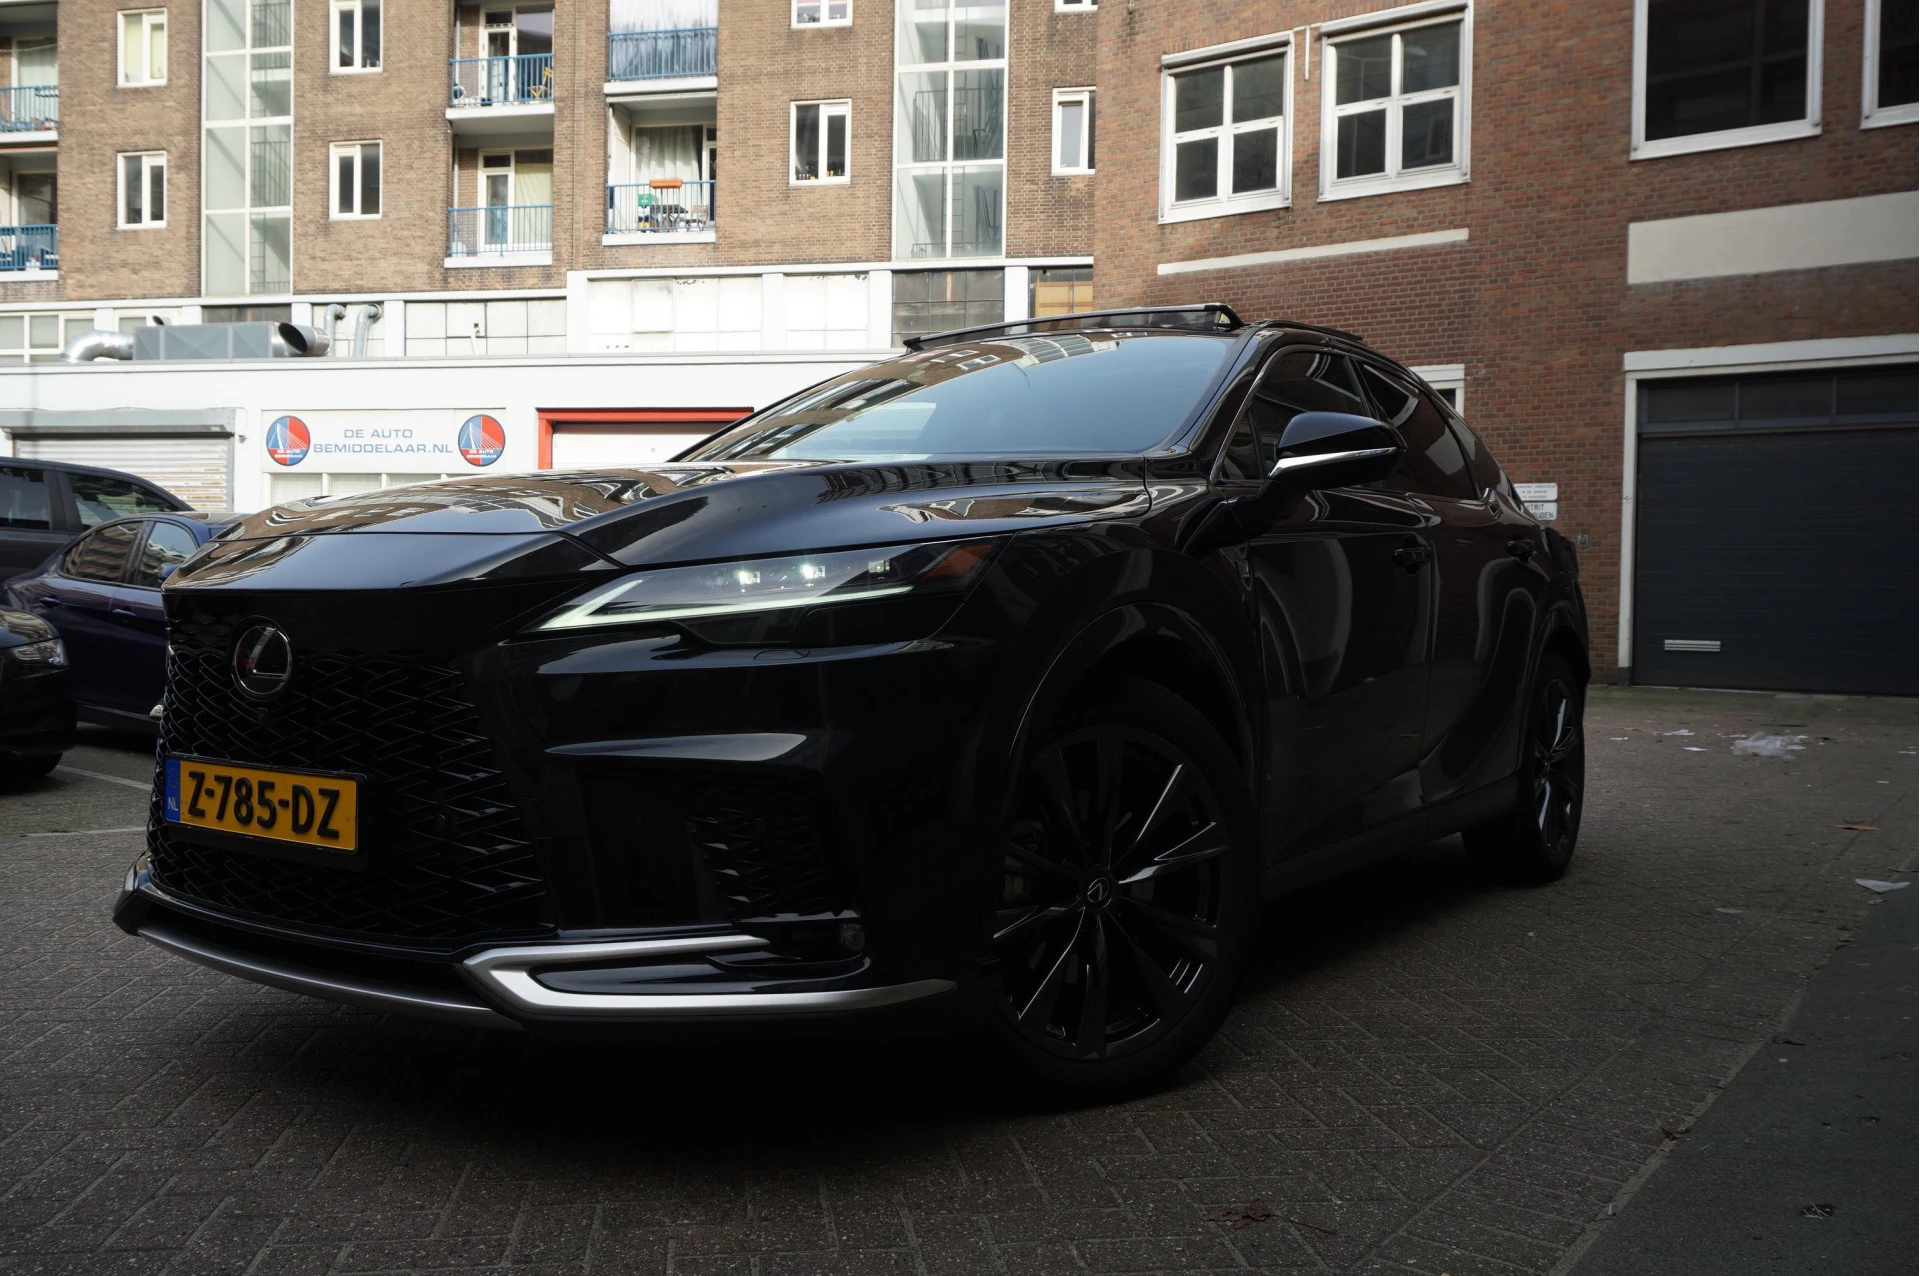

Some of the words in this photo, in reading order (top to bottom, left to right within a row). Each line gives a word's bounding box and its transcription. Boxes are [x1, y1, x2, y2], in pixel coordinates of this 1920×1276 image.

[344, 429, 364, 438] DE
[371, 429, 413, 438] AUTO
[313, 444, 453, 453] BEMIDDELAAR.NL
[168, 797, 178, 812] NL
[188, 771, 340, 839] Z-785-DZ
